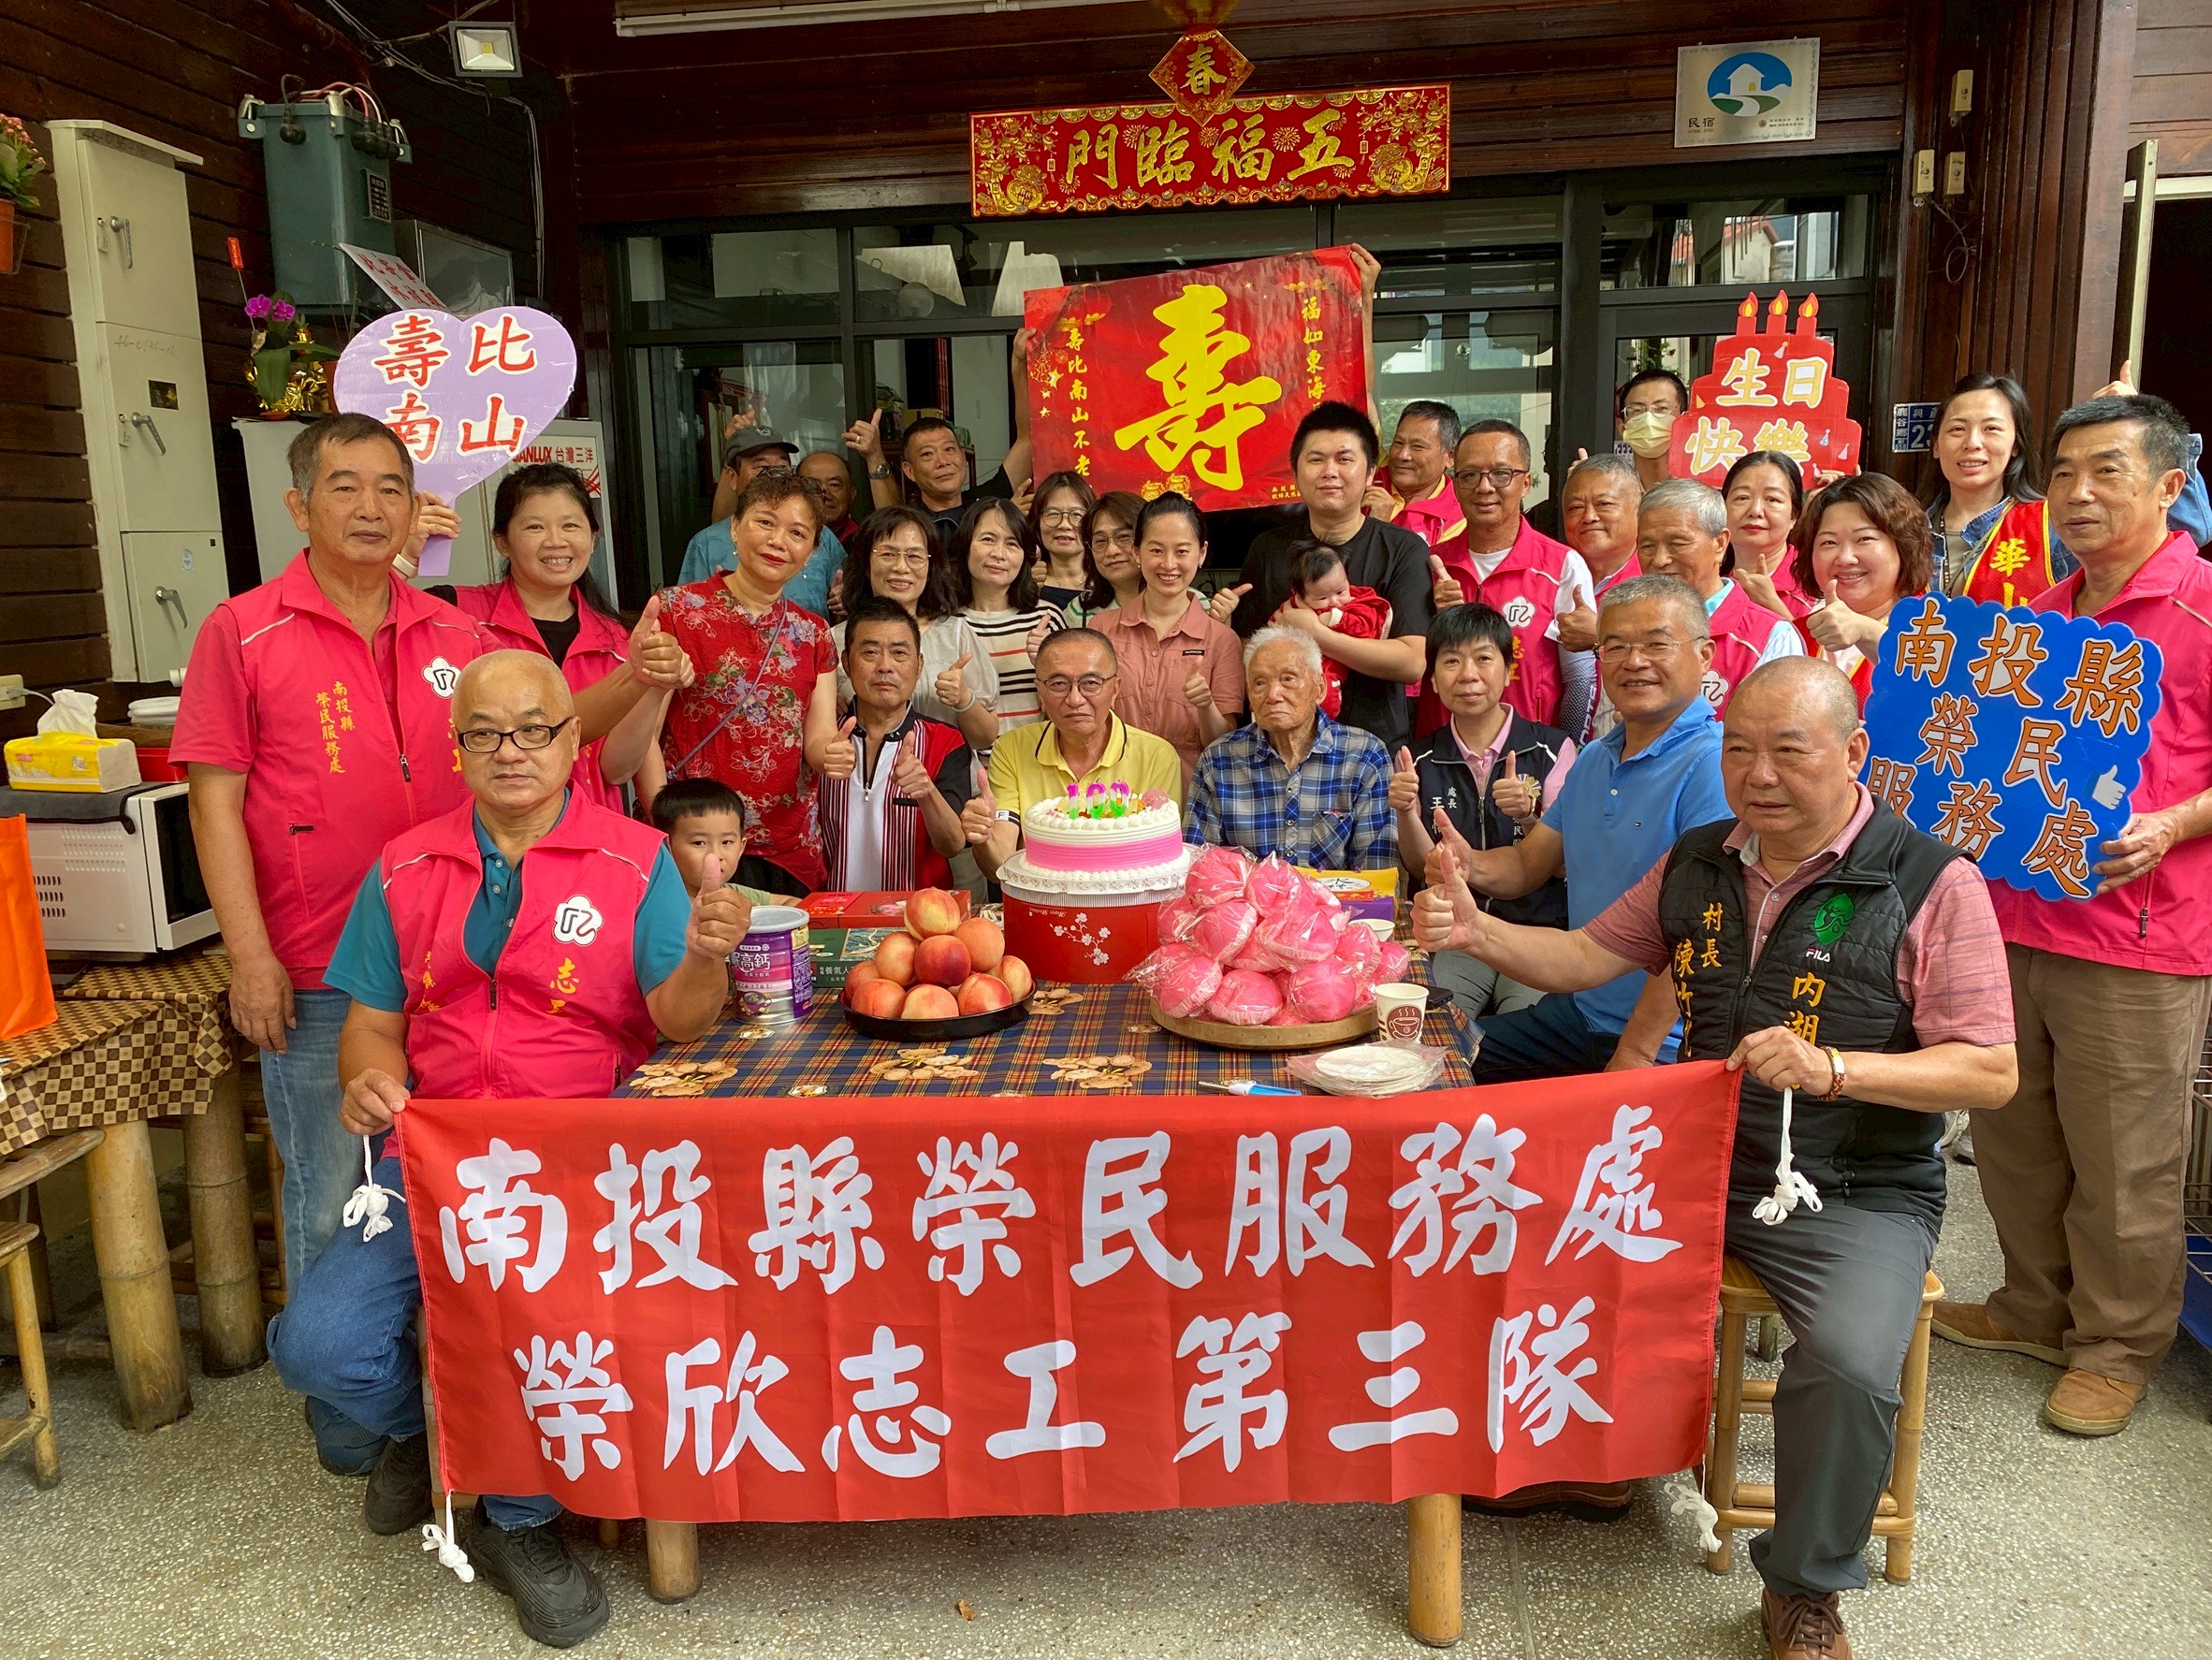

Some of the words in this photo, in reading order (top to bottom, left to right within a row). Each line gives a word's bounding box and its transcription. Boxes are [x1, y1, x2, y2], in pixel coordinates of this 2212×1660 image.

[1181, 43, 1228, 95] 春
[1688, 117, 1715, 128] 民宿
[374, 314, 535, 386] 壽比
[1302, 297, 1327, 409] 福如東海
[1716, 348, 1827, 408] 生日
[1065, 328, 1092, 487] 壽比南山不老
[1114, 284, 1283, 491] 壽
[384, 392, 526, 461] 南山
[556, 446, 593, 463] 台灣三洋
[1685, 417, 1812, 475] 快樂
[1895, 599, 2143, 736] 南投縣
[333, 681, 355, 731] 南投縣
[1916, 692, 2067, 807] 榮民
[1868, 757, 2097, 896] 服務處
[1700, 902, 1724, 968] 村長
[1805, 948, 1830, 963] FILA
[825, 967, 853, 975] 養氣人
[439, 1104, 1683, 1296] 南投縣榮民服務處
[514, 1296, 1614, 1481] 榮欣志工第三隊
